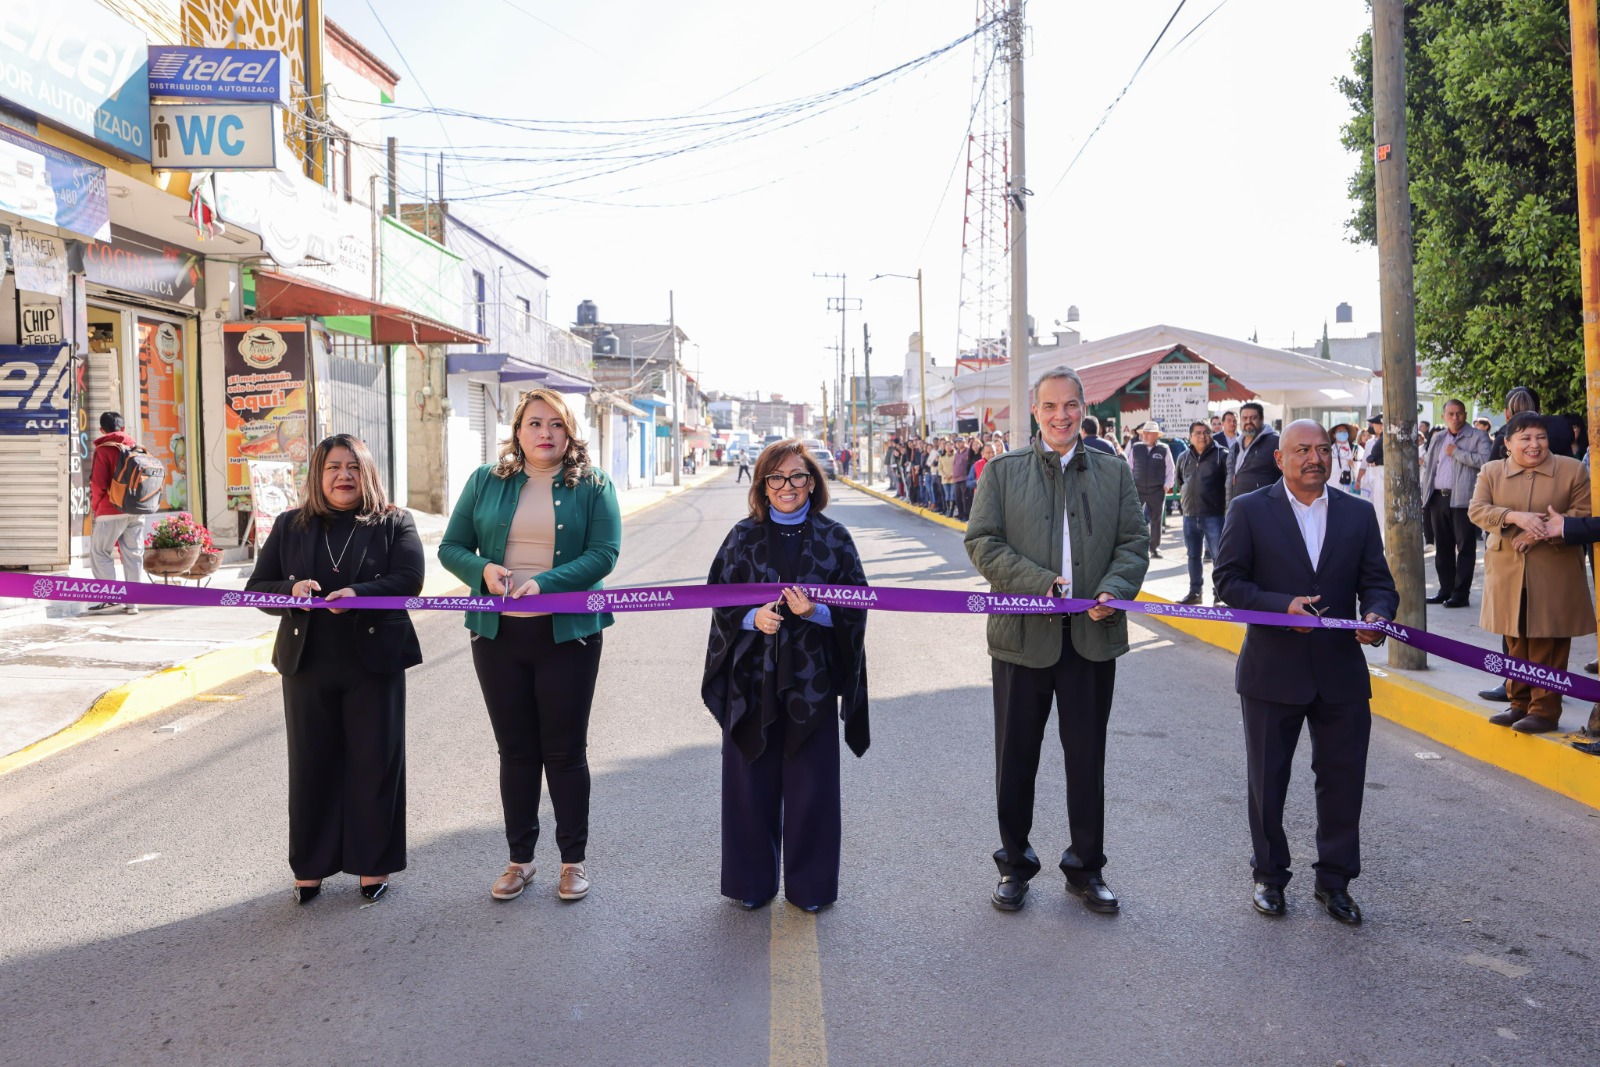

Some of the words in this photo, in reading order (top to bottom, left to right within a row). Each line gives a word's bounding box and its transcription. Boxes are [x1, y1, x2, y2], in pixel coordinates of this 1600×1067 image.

[182, 55, 277, 83] telcel
[149, 82, 213, 91] DISTRIBUIDOR
[218, 85, 275, 93] AUTORIZADO
[38, 80, 143, 147] AUTORIZADO
[175, 114, 245, 156] WC
[87, 241, 156, 280] COCINA
[23, 308, 55, 333] CHIP
[240, 374, 265, 384] mejor
[266, 371, 291, 380] sazón
[228, 385, 246, 393] solo
[247, 383, 255, 391] lo
[256, 381, 303, 389] encuentras
[232, 391, 285, 412] aquí!
[25, 419, 68, 429] AUT
[70, 487, 91, 518] $25
[55, 580, 128, 596] TLAXCALA
[809, 587, 878, 601] TLAXCALA
[243, 593, 313, 606] TLAXCALA
[426, 598, 495, 607] TLAXCALA
[606, 590, 674, 604] TLAXCALA
[986, 596, 1056, 608] TLAXCALA
[1163, 604, 1234, 617] TLAXCALA
[1504, 658, 1573, 688] TLAXCALA
[1521, 675, 1540, 684] NUEVA
[1540, 680, 1568, 692] HISTORIA
